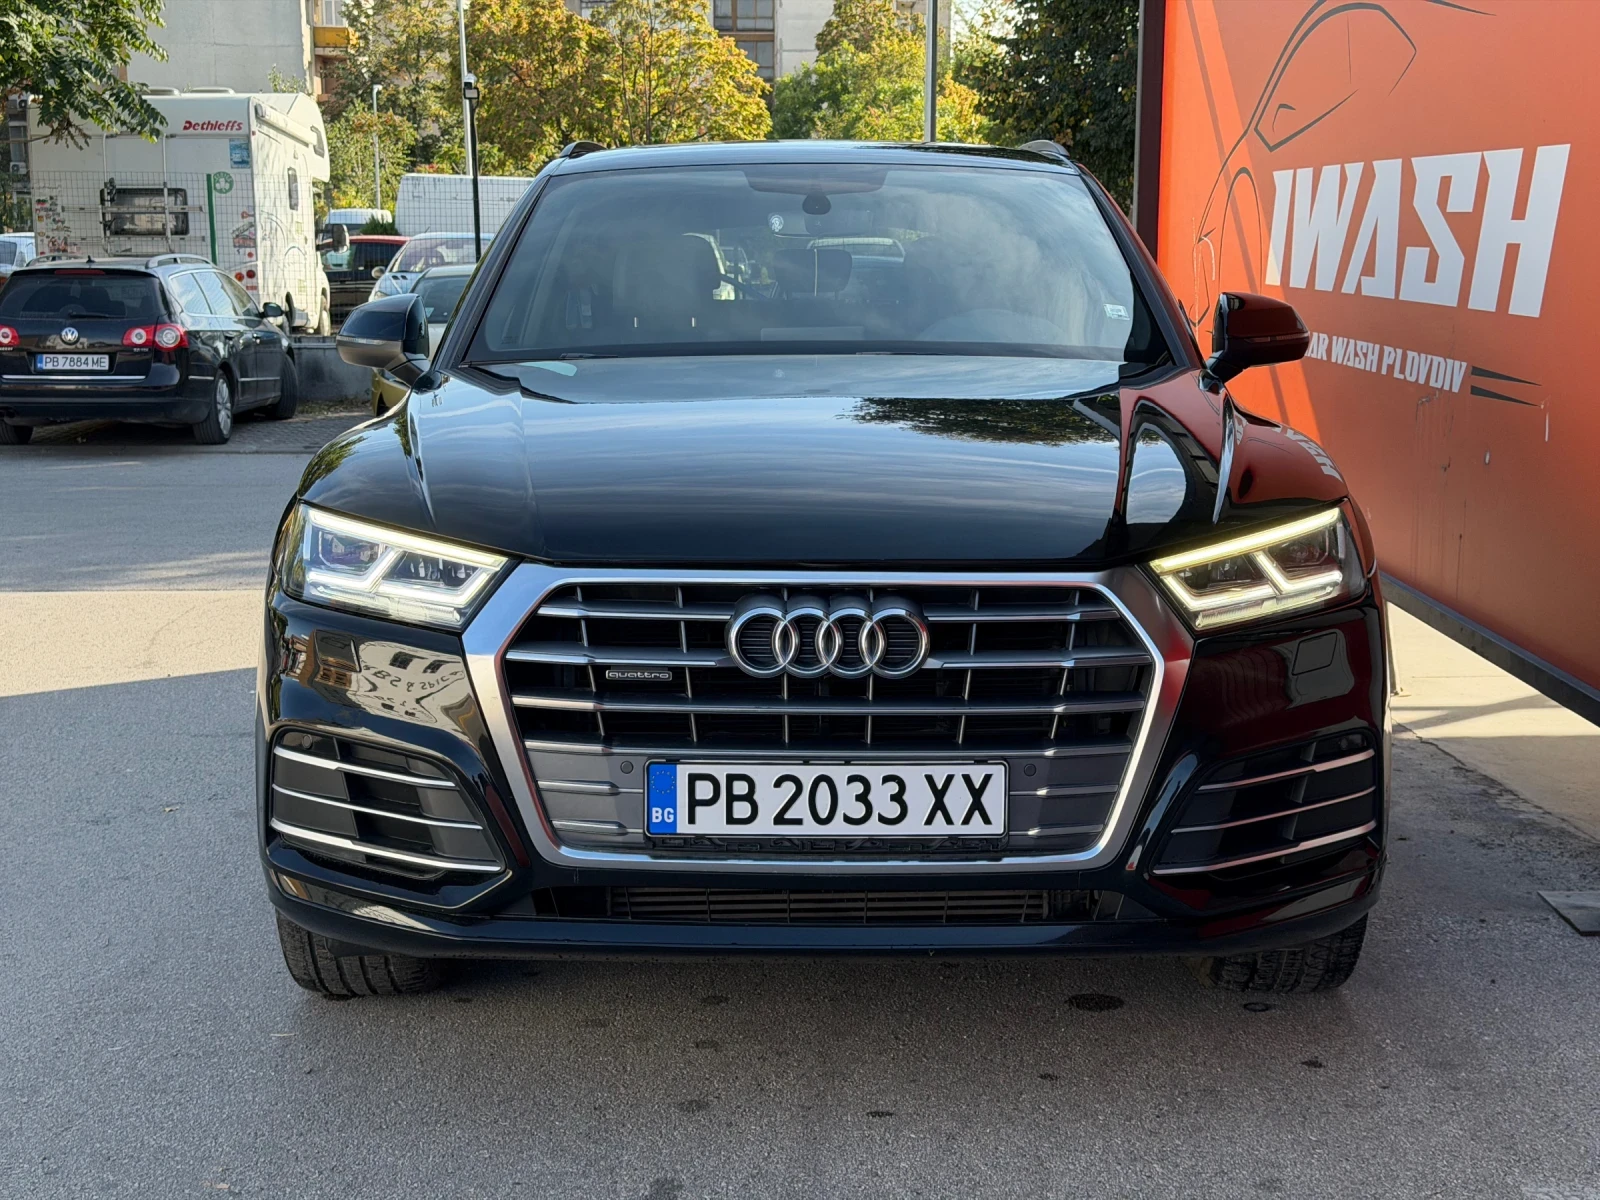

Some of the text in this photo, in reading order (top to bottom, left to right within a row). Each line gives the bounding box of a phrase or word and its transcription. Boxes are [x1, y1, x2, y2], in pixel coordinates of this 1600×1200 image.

[183, 120, 244, 131] Dethleffs
[1265, 143, 1571, 318] IWASH
[44, 356, 60, 368] PB
[61, 356, 89, 368] 7884
[91, 356, 107, 368] ME
[1304, 331, 1468, 394] AR WASH PLOVDIV
[608, 671, 670, 680] quattro
[687, 773, 993, 828] PB 2033 XX
[651, 807, 675, 823] BG
